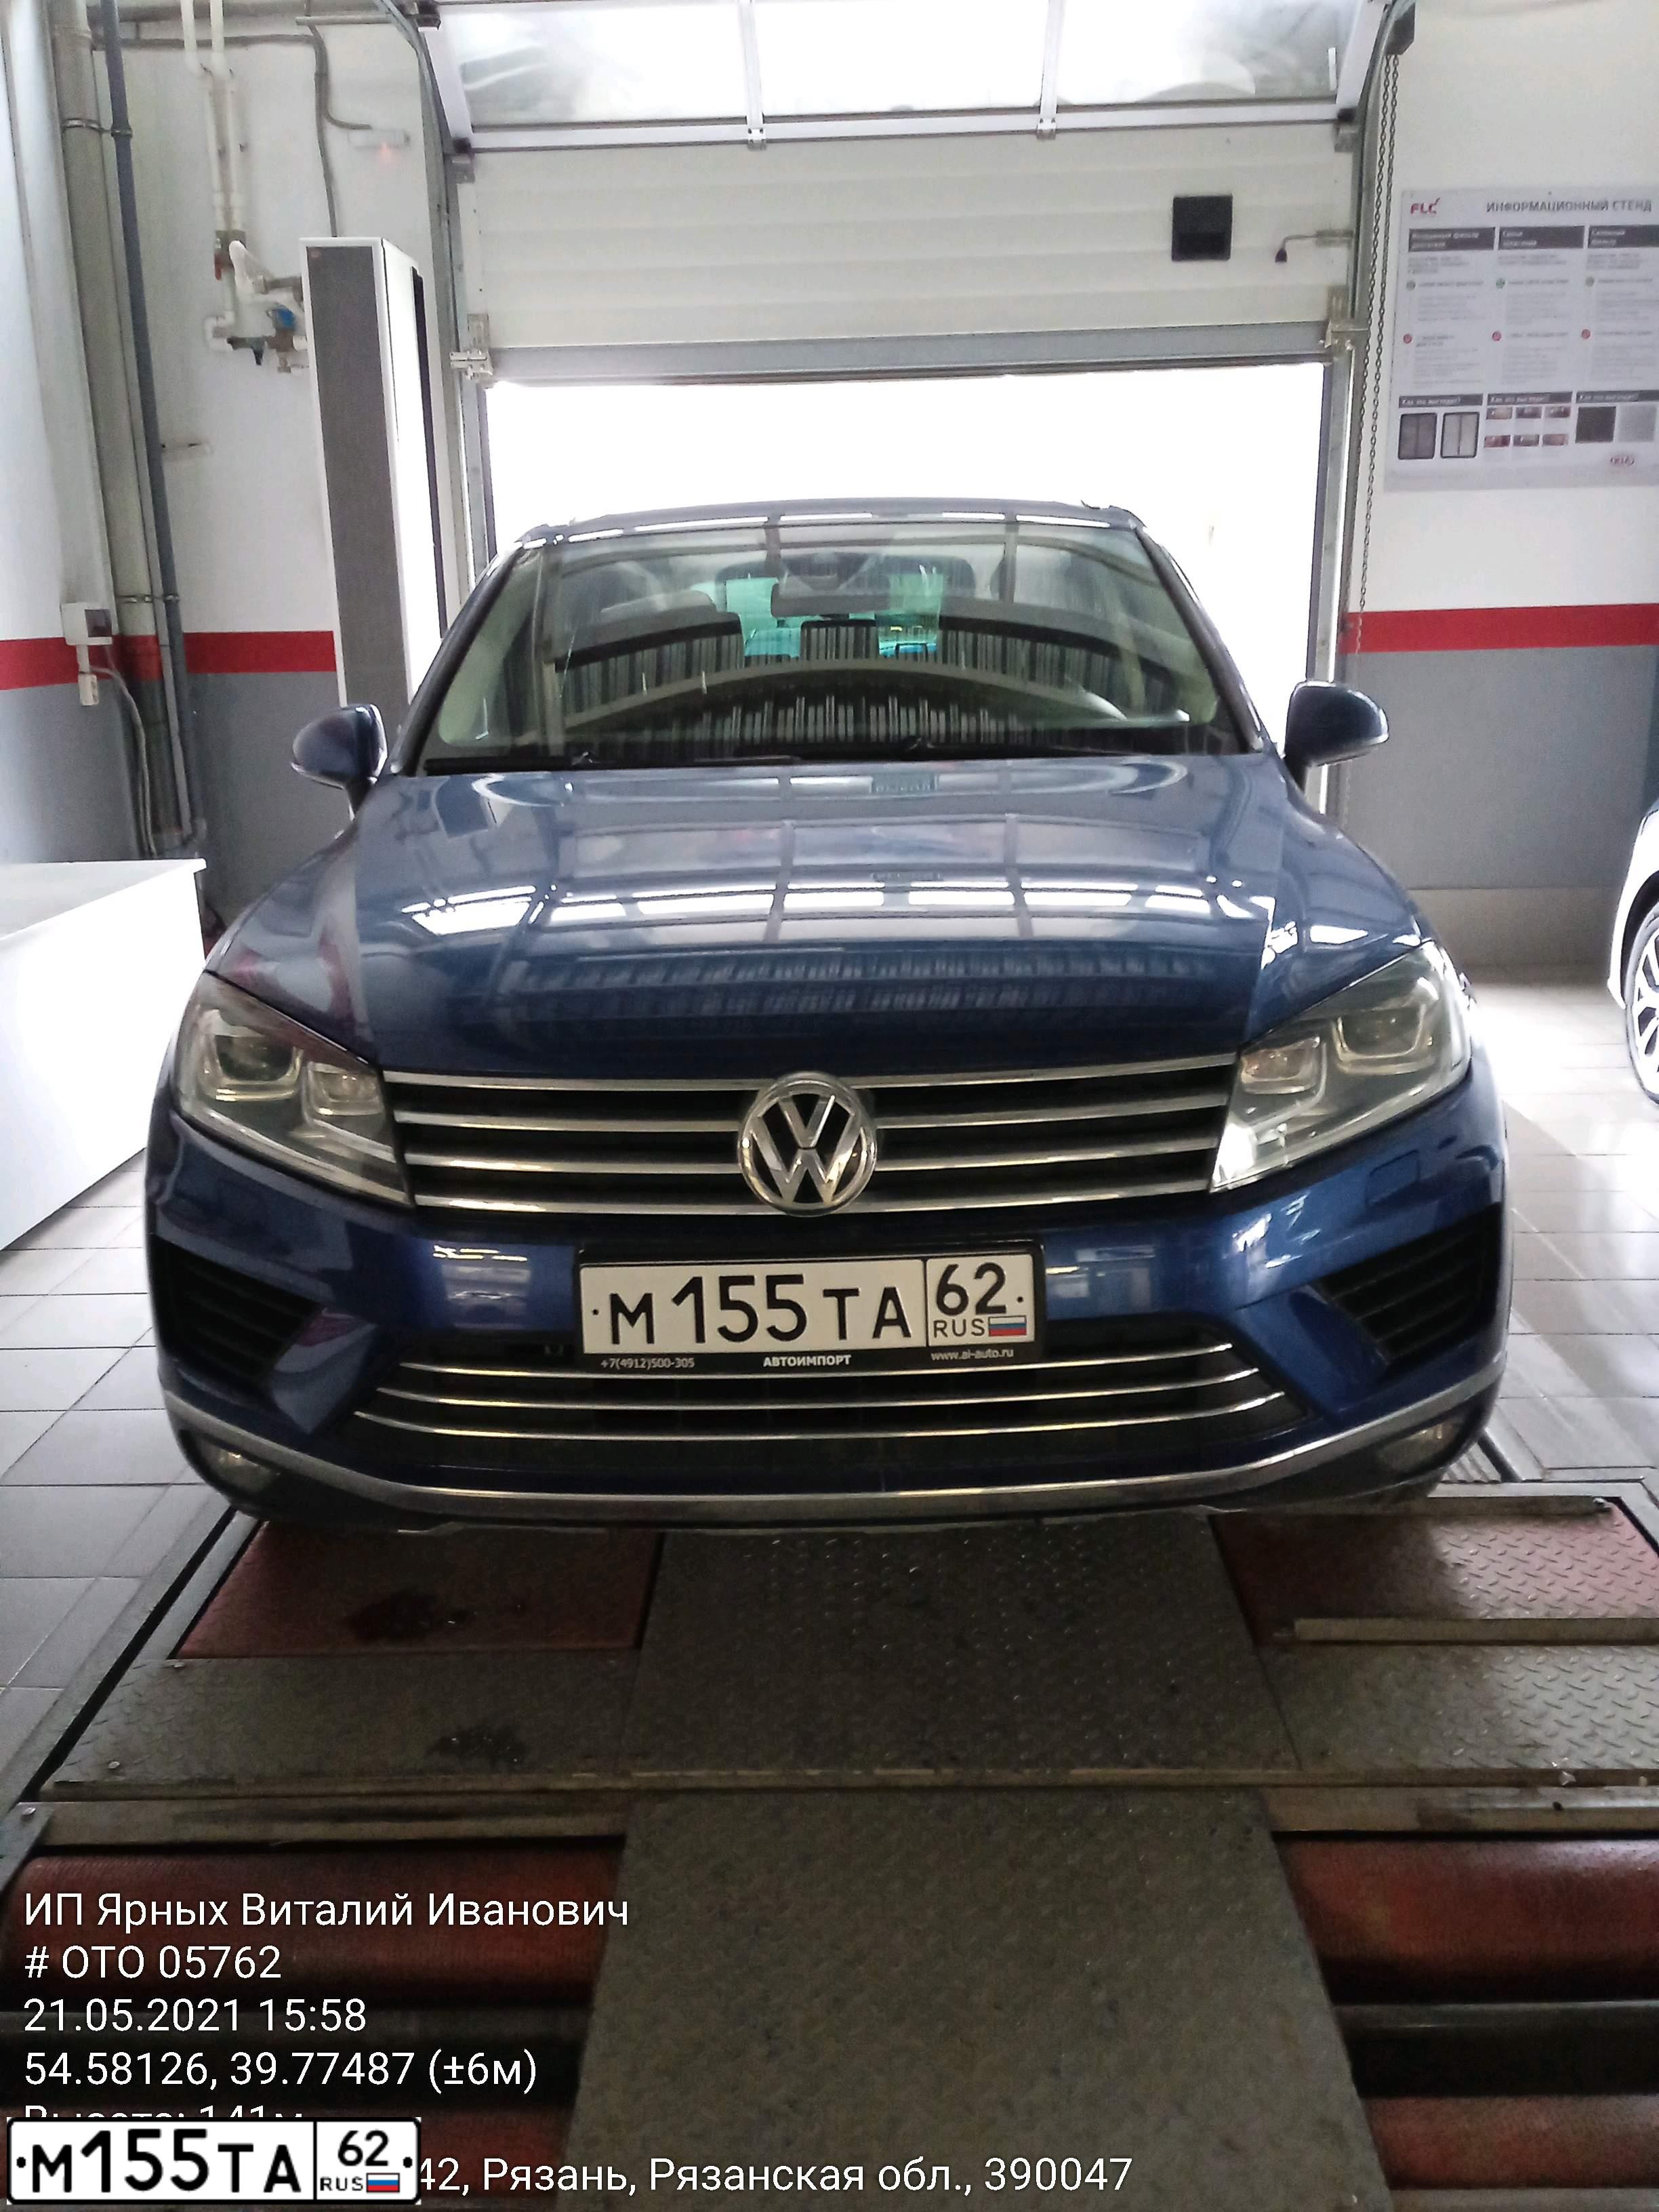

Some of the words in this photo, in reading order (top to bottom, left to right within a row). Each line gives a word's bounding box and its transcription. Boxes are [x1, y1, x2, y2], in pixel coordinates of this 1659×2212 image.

[1486, 199, 1609, 213] ИНФОРМАЦИОННЫЙ
[1612, 199, 1652, 212] СТЕНД
[936, 1263, 1006, 1315] 62
[933, 1317, 985, 1338] RUS
[762, 1354, 852, 1368] АВТОИМПОРТ
